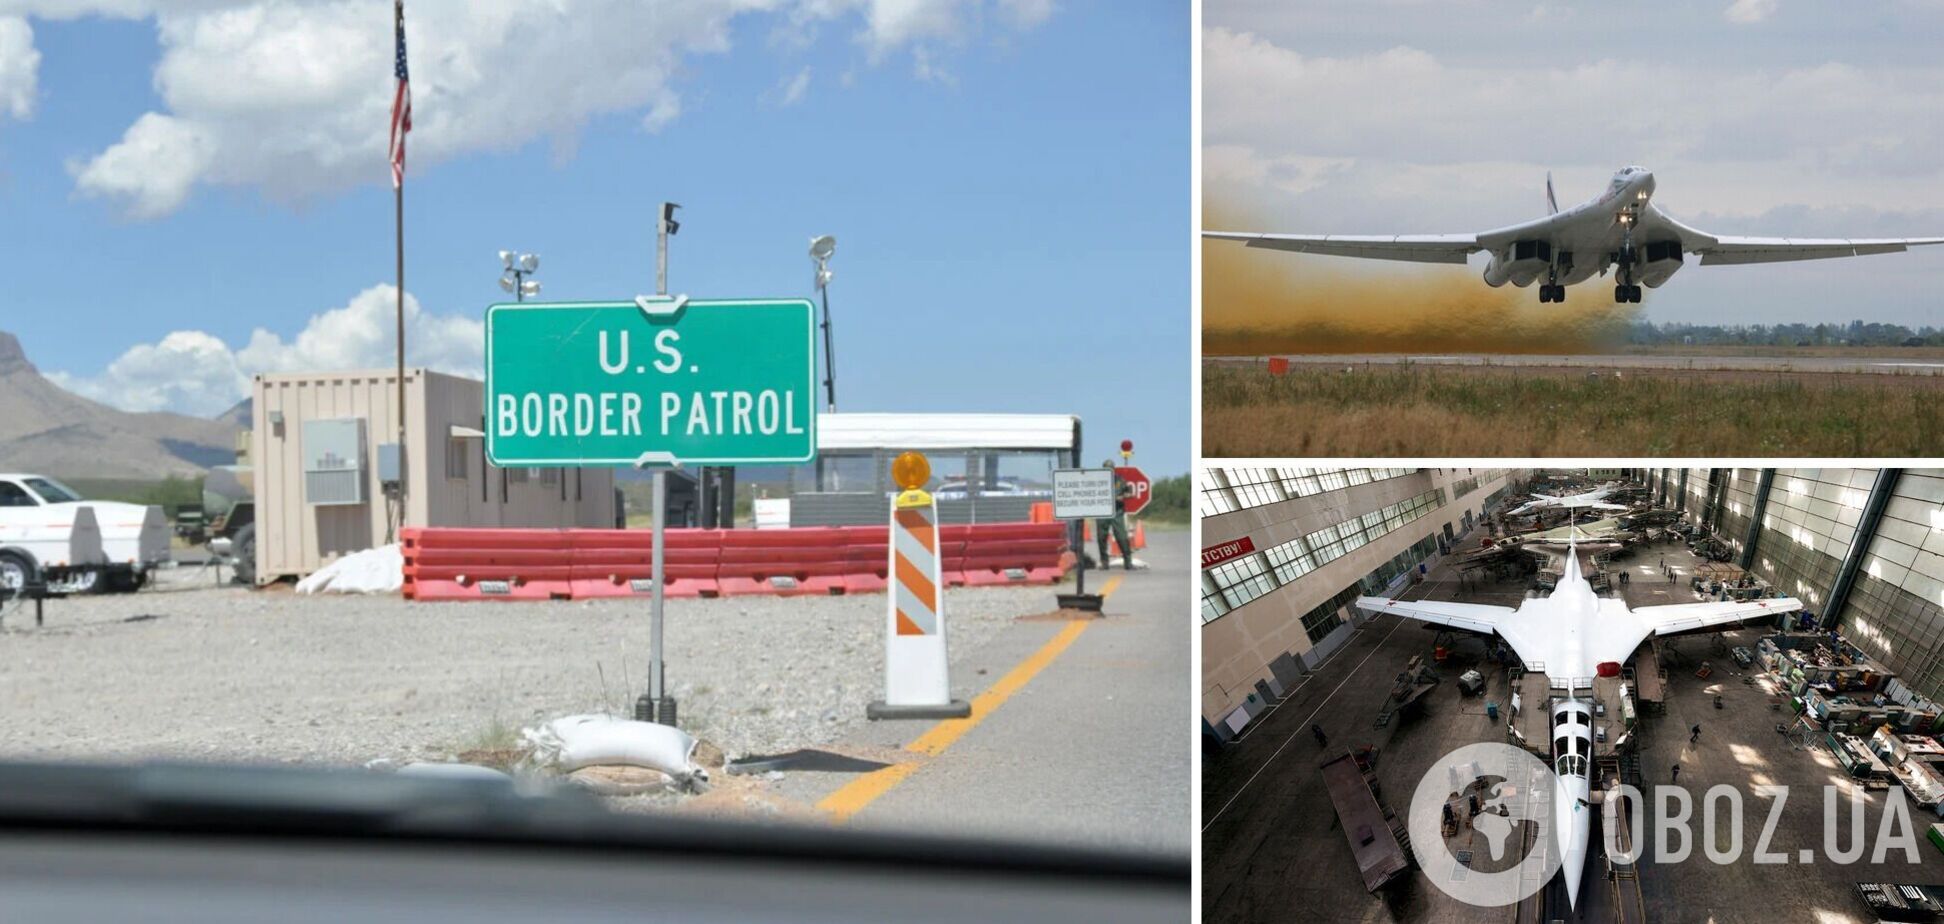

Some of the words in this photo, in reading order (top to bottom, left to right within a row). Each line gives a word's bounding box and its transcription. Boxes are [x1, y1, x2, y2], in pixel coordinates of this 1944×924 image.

[599, 329, 699, 375] U.S.
[498, 392, 642, 437] BORDER
[660, 389, 804, 436] PATROL
[1126, 481, 1147, 499] OP
[1202, 541, 1242, 563] ТСТВУ!
